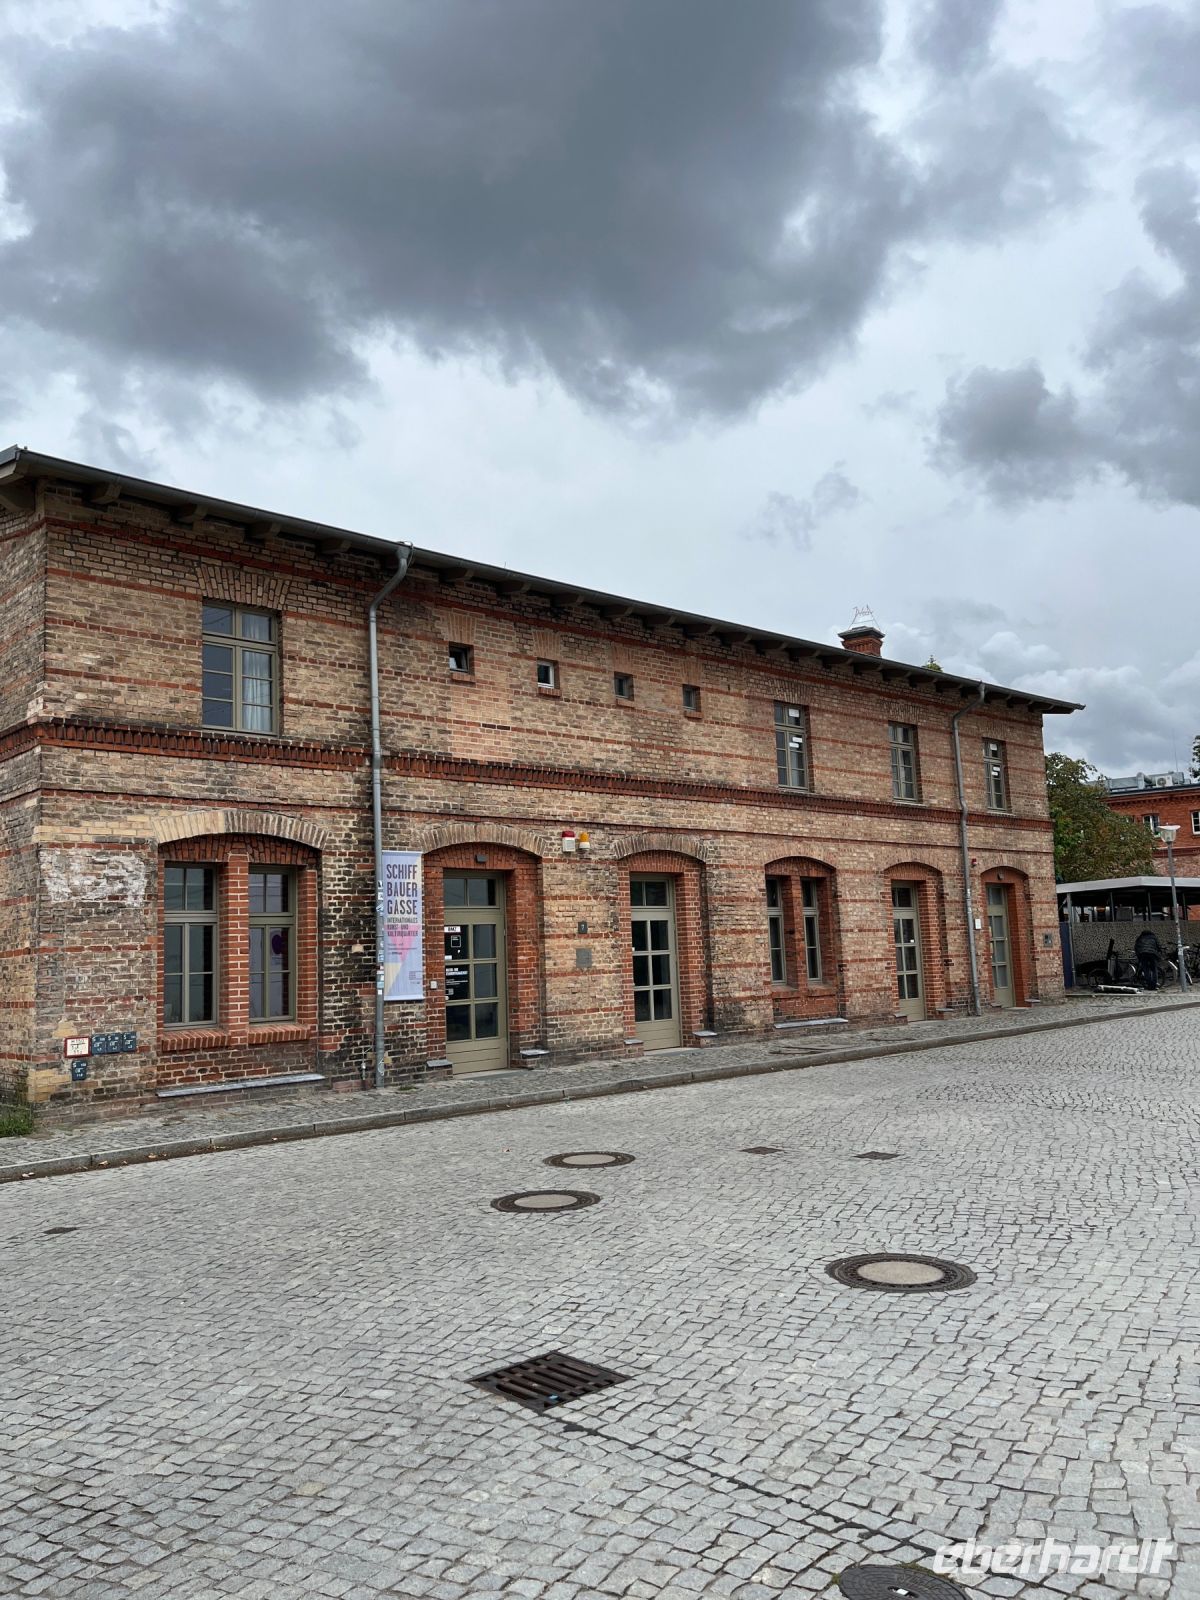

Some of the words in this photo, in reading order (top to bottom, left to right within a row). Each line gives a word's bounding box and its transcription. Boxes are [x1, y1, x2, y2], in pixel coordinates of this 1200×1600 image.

[386, 864, 418, 879] SCHIFF
[387, 882, 418, 897] BAUER
[387, 900, 418, 915] GASSE
